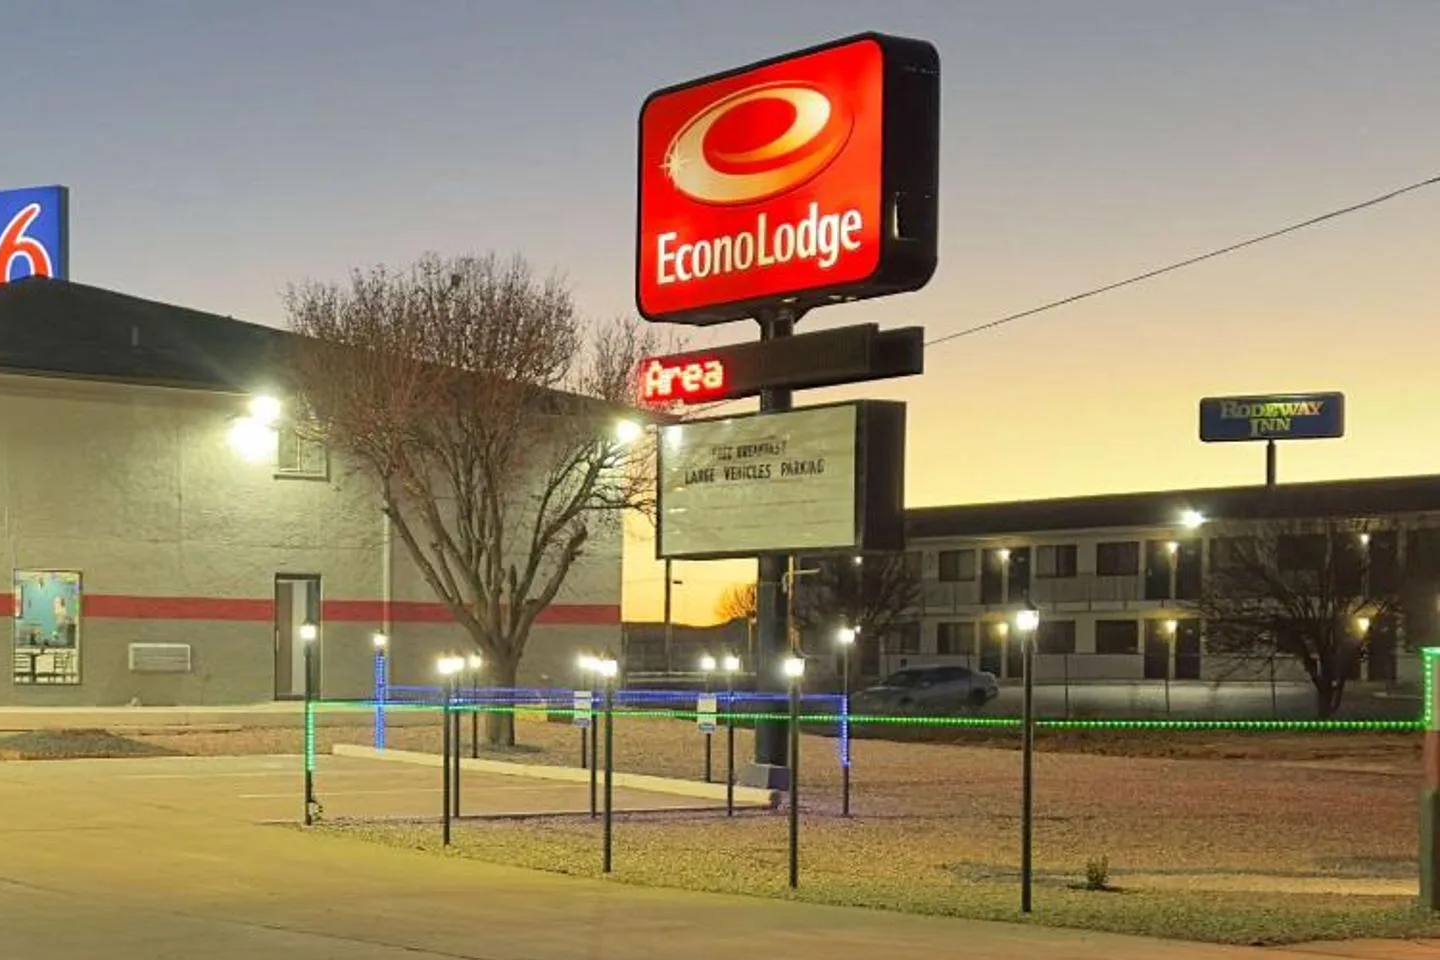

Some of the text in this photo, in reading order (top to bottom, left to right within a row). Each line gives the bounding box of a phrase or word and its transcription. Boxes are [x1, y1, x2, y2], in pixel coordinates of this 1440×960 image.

[656, 202, 863, 285] EconoLodge
[646, 360, 724, 398] Area
[684, 458, 826, 485] LARGE VEHICLES PARKING
